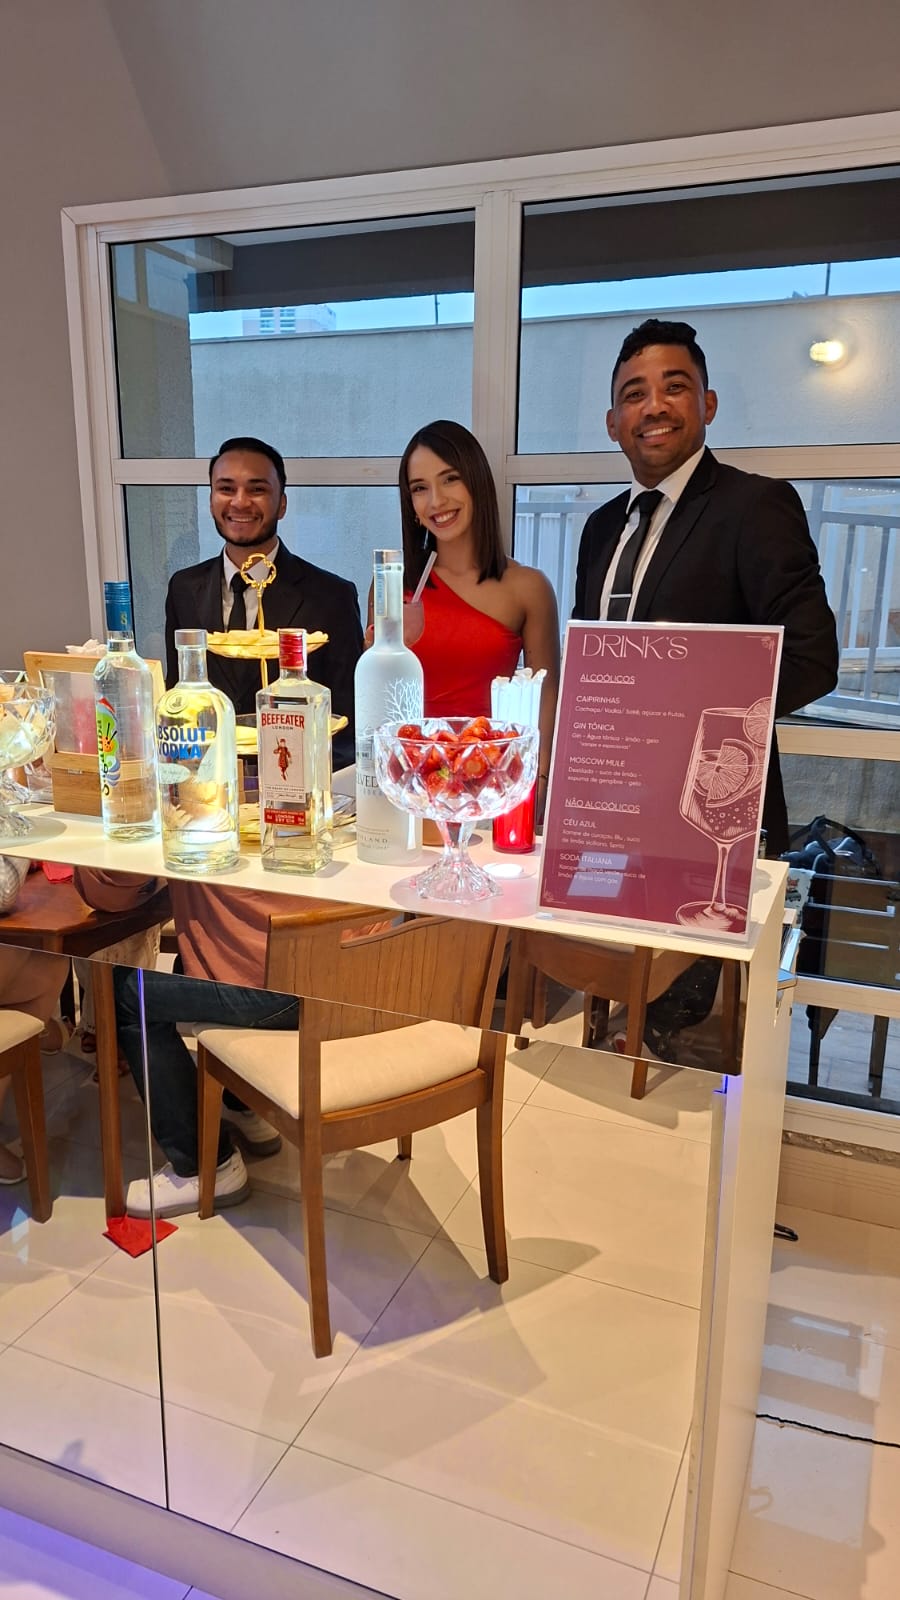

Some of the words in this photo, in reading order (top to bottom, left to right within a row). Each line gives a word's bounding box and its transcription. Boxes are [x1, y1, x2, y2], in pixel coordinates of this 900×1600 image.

[582, 633, 688, 660] DRINK'S
[576, 695, 620, 704] CAIPIRINHAS
[261, 712, 304, 730] BEEFEATER
[573, 722, 586, 730] GIN
[588, 722, 615, 732] TÔNICA
[157, 725, 208, 742] BSOLUT
[570, 756, 605, 766] MOSCOW
[606, 760, 625, 768] MULE
[564, 797, 584, 808] NÃO
[563, 818, 578, 826] CÉU
[579, 820, 597, 828] AZUL
[560, 852, 580, 862] SODA
